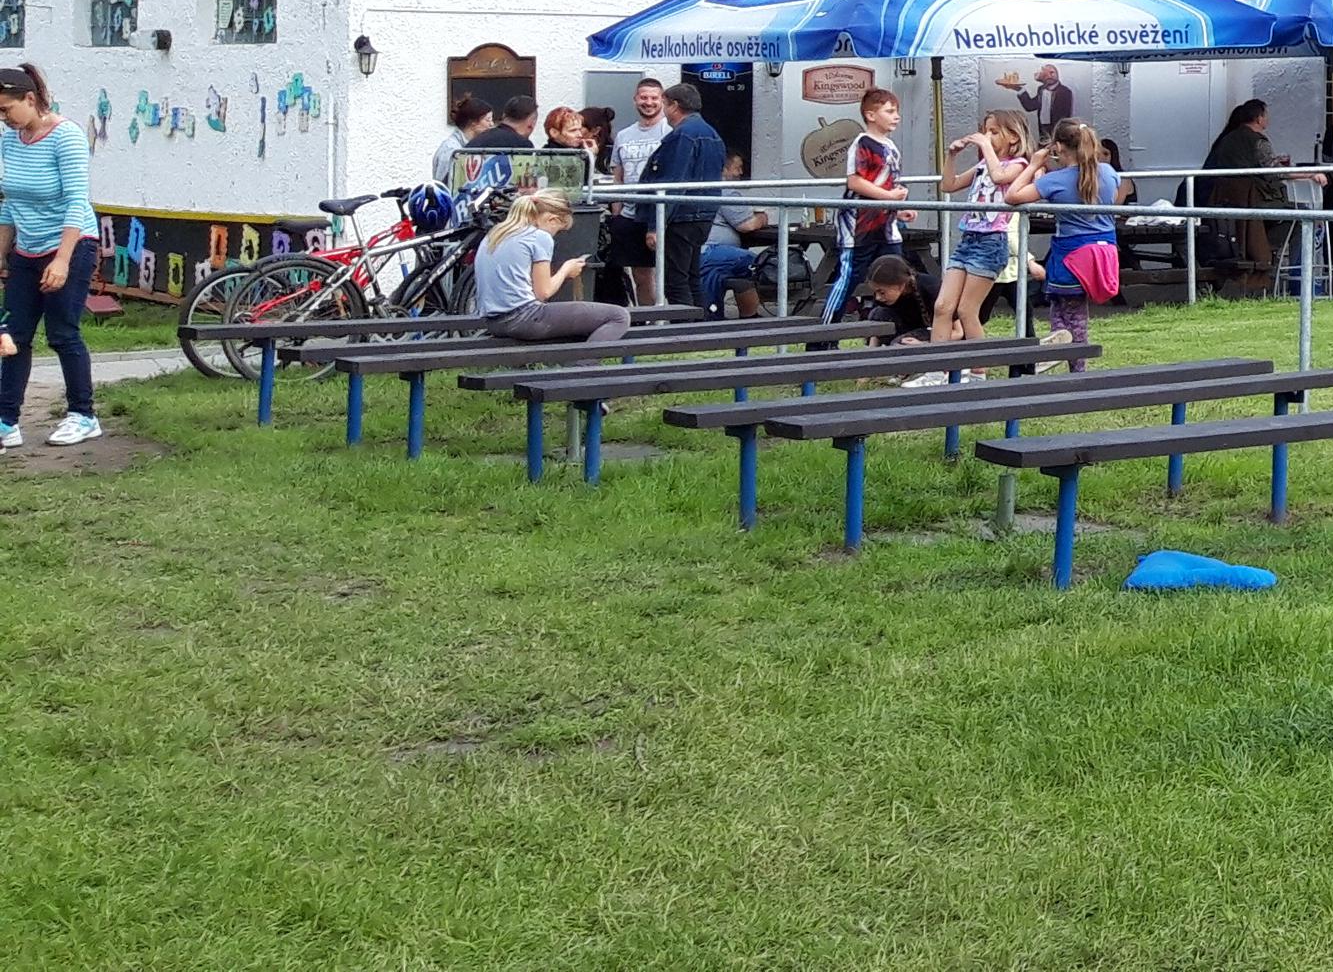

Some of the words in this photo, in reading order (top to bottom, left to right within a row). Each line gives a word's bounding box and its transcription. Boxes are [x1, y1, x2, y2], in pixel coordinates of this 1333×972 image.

[641, 33, 722, 60] Nealkoholické
[727, 35, 780, 59] osvěžení
[954, 23, 1099, 50] Nealkoholické
[1106, 25, 1191, 46] osvěžení
